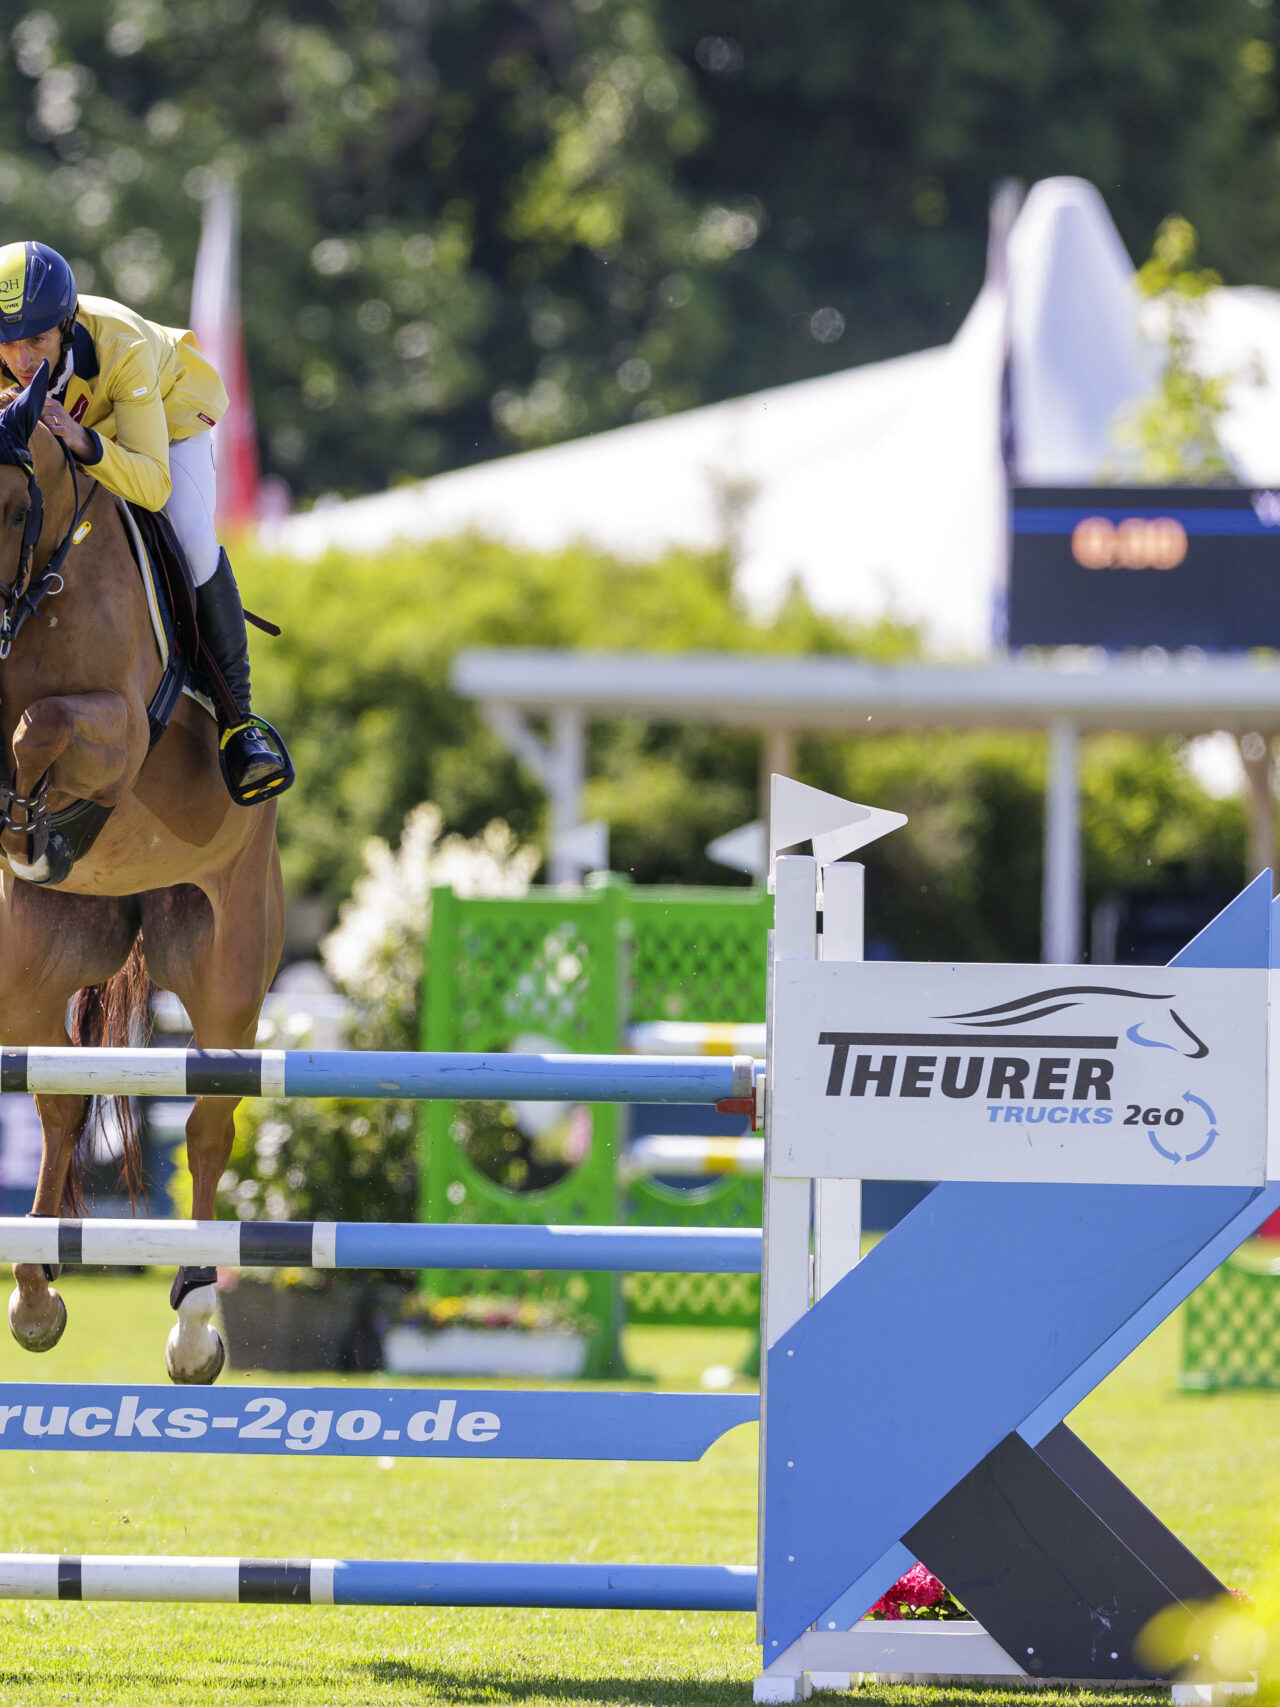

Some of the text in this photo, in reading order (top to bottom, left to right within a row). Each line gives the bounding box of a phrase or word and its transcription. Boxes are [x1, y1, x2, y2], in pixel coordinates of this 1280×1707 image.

[818, 1032, 1118, 1101] THEURER
[986, 1104, 1184, 1126] TRUCKS 2GO
